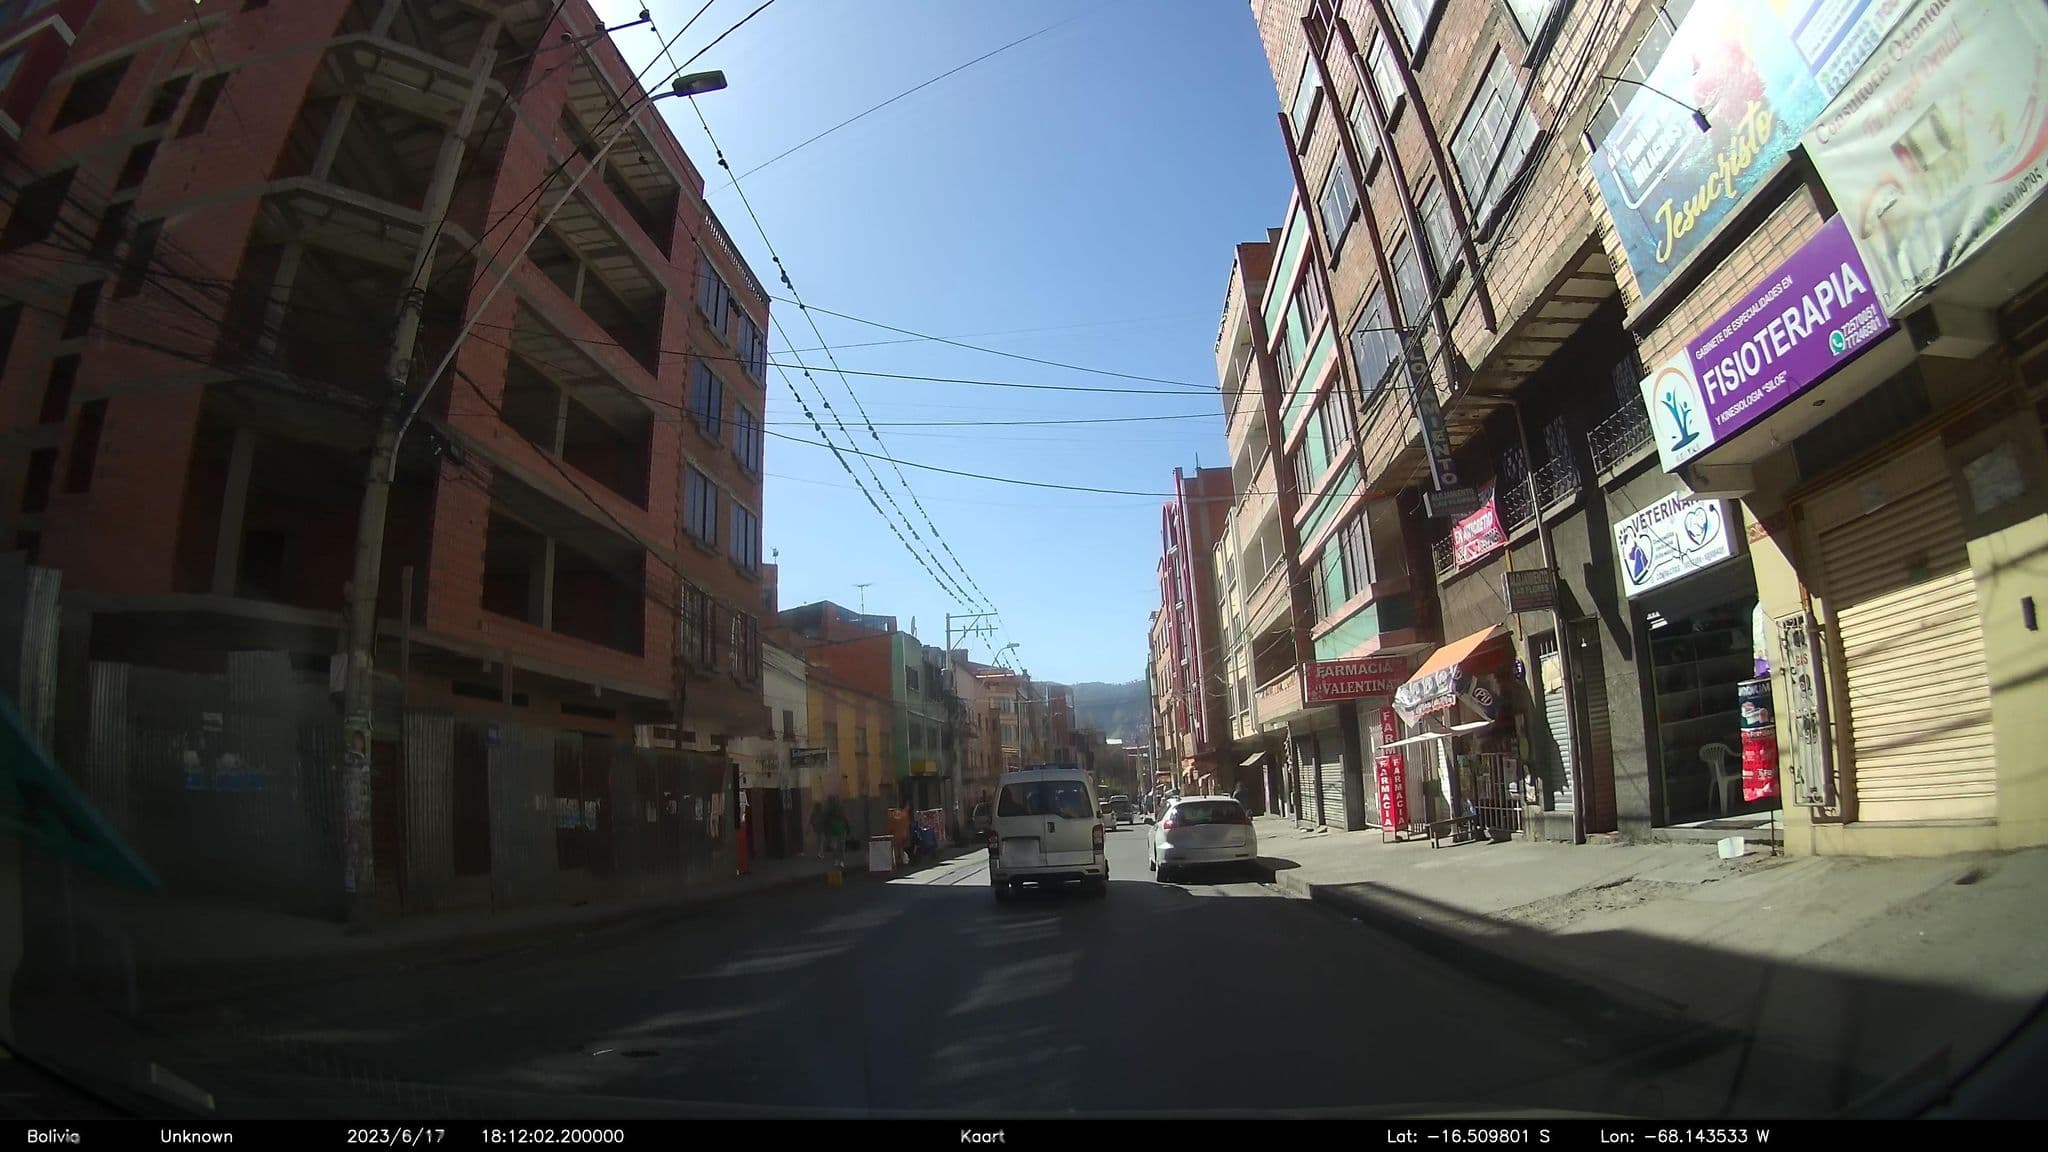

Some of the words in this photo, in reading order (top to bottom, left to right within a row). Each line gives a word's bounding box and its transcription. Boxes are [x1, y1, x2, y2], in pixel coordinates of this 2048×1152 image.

[1655, 99, 1774, 264] Jesucristo
[1695, 330, 1724, 360] GABINETE
[1723, 323, 1735, 340] DE
[1732, 284, 1784, 335] ESPECIALIDADES
[1782, 275, 1793, 290] EN
[1702, 262, 1867, 406] FISIOTERAPIA
[1720, 390, 1764, 424] KINESIOLOGIA
[1632, 497, 1698, 533] VETERINA
[1316, 662, 1393, 679] FARMACIA
[1378, 758, 1392, 827] FARMACIA
[1392, 757, 1406, 826] FARMACIA
